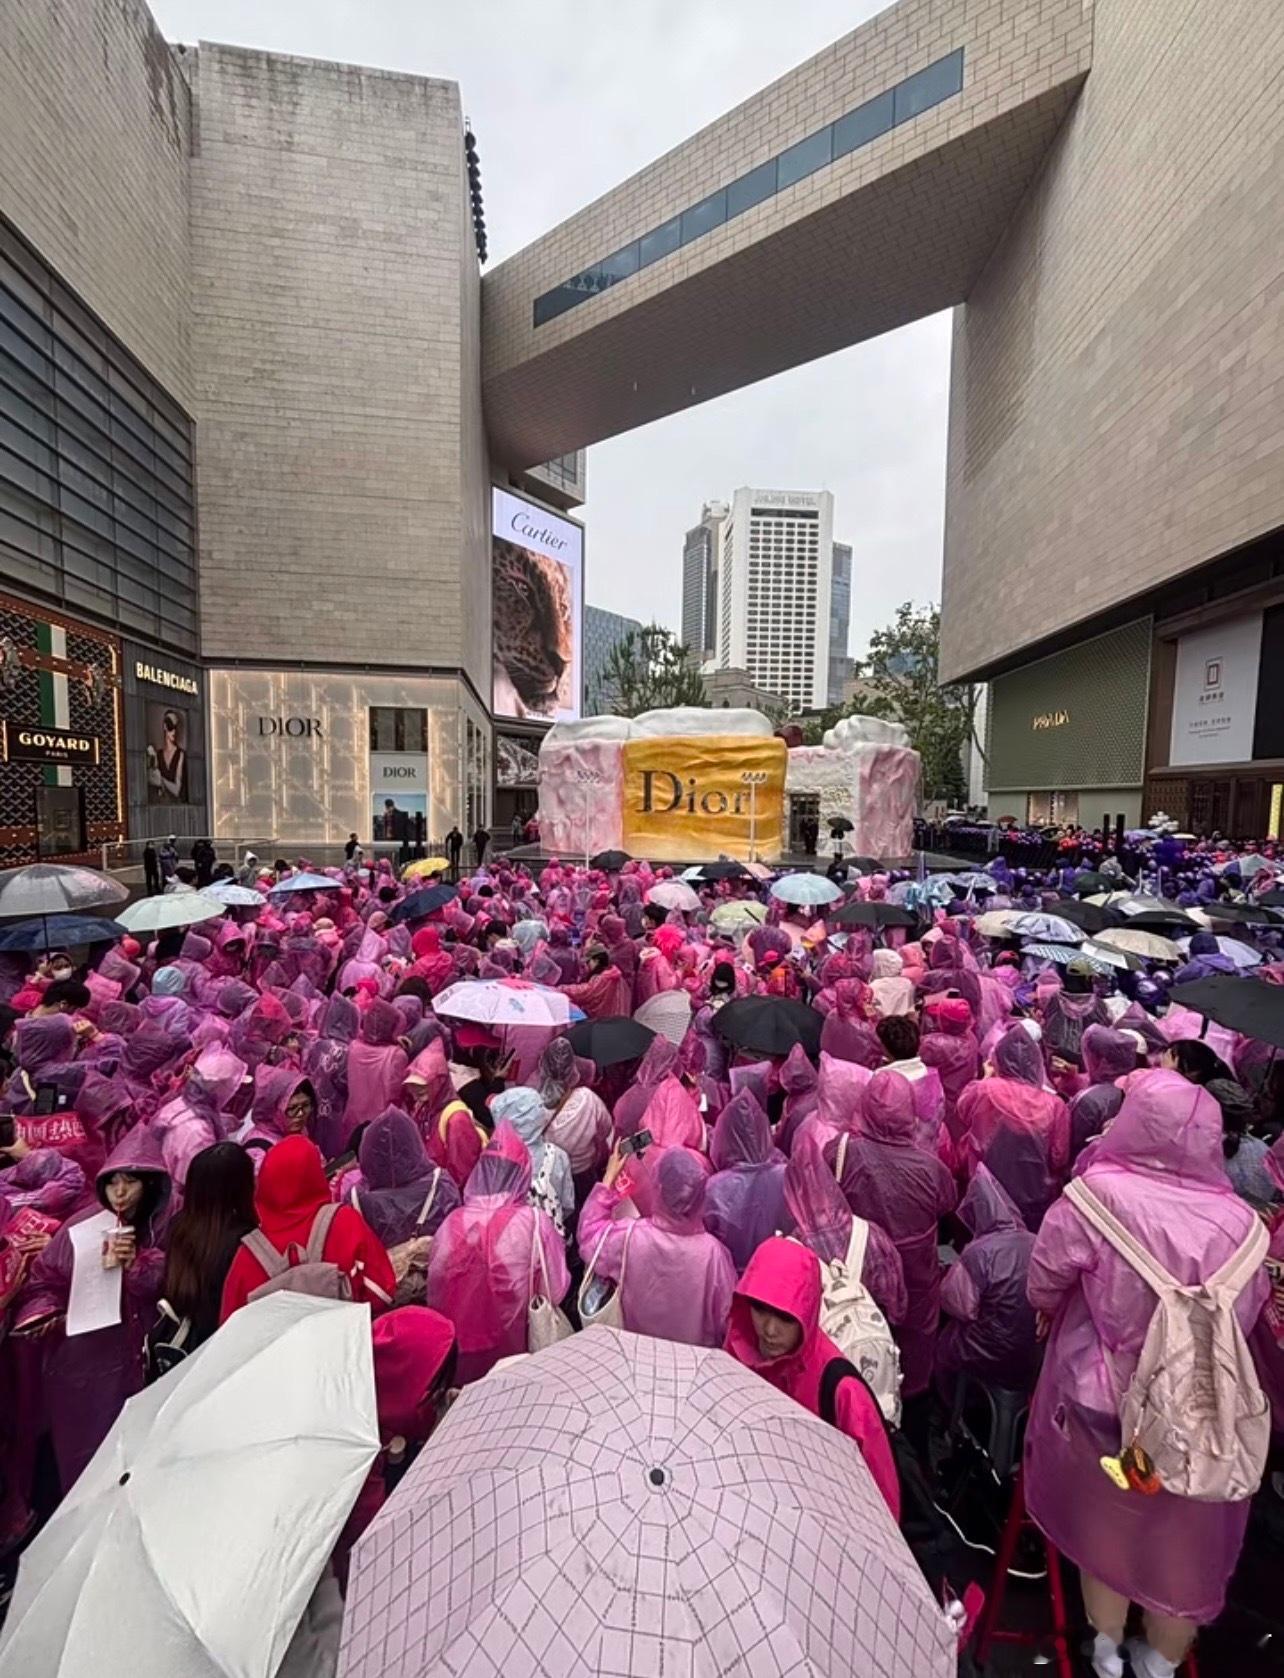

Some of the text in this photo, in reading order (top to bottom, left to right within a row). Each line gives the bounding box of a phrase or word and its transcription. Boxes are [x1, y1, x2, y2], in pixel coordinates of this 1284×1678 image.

[511, 511, 568, 550] Cartier
[136, 661, 198, 695] BALENCIAGA
[259, 716, 323, 738] DIOR
[18, 732, 90, 751] GOYARD
[45, 750, 69, 758] PARIS
[383, 766, 417, 778] DIOR
[635, 769, 752, 814] Dior
